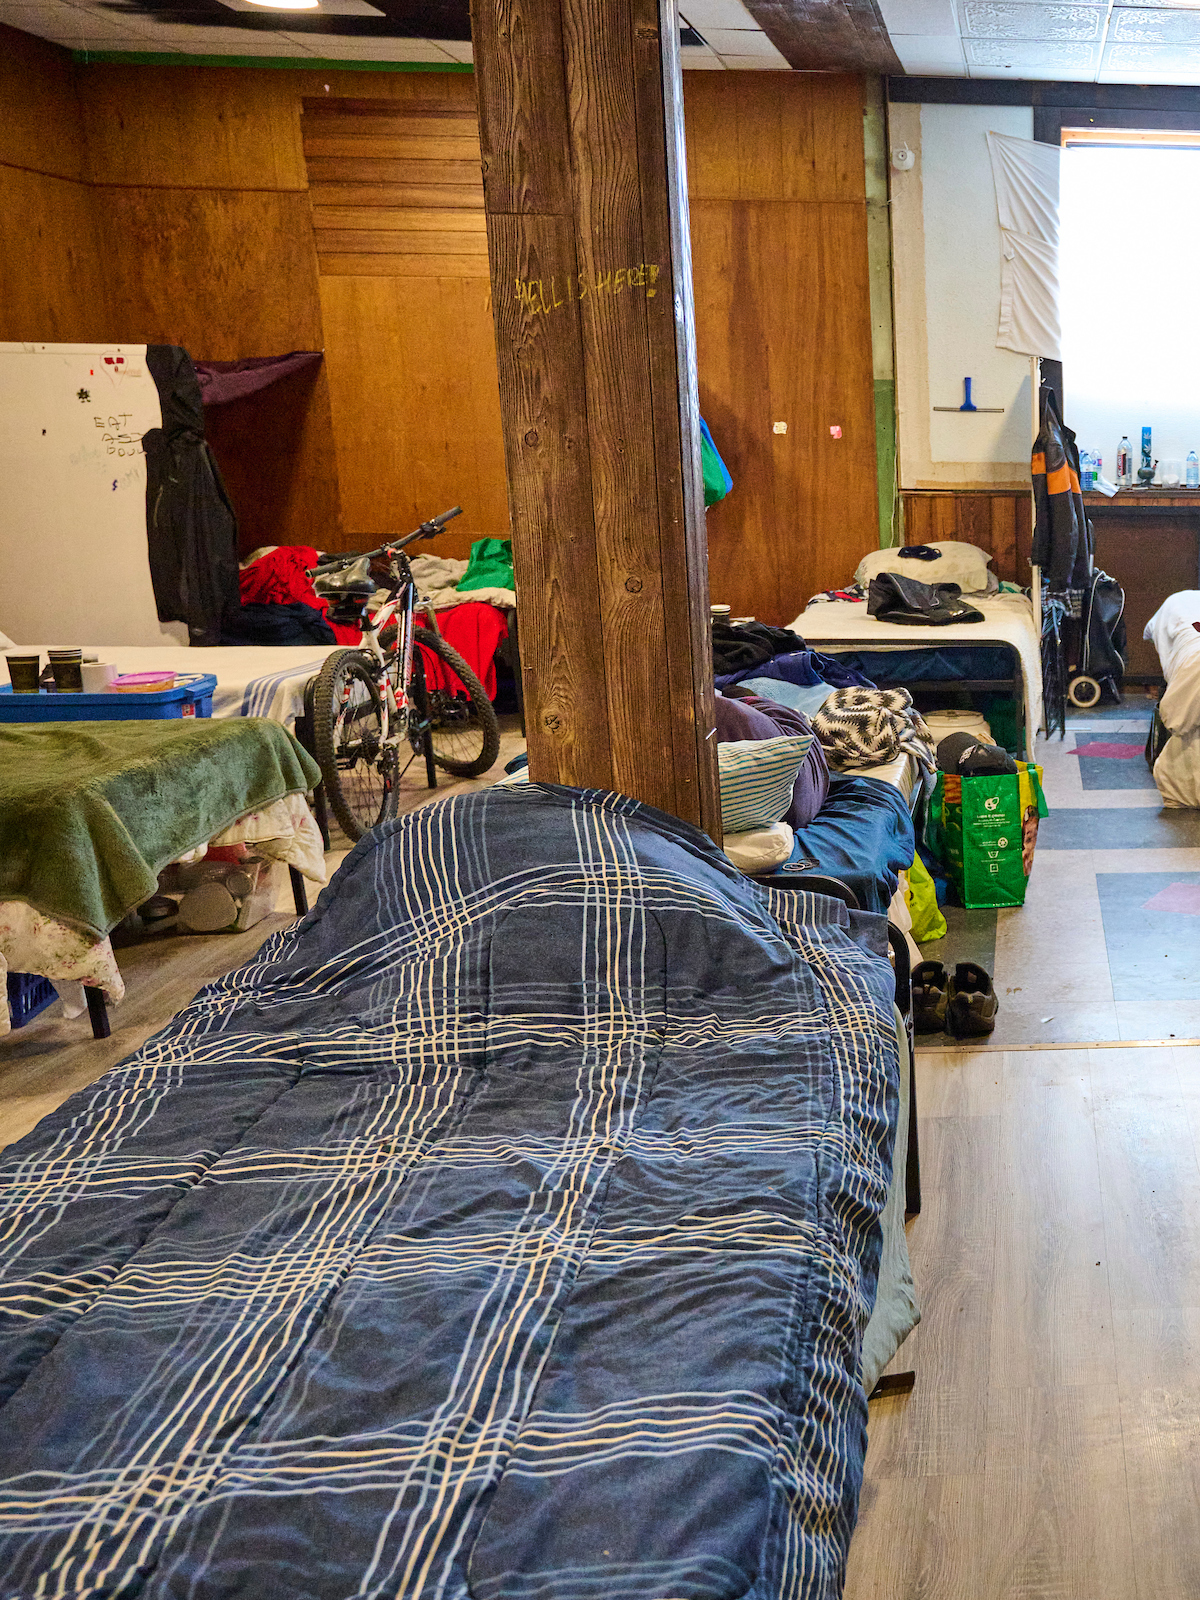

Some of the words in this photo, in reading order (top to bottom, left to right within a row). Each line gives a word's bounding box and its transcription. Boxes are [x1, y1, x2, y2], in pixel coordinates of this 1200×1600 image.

[514, 275, 563, 315] HELL
[567, 273, 586, 302] IS
[94, 413, 133, 431] EAT
